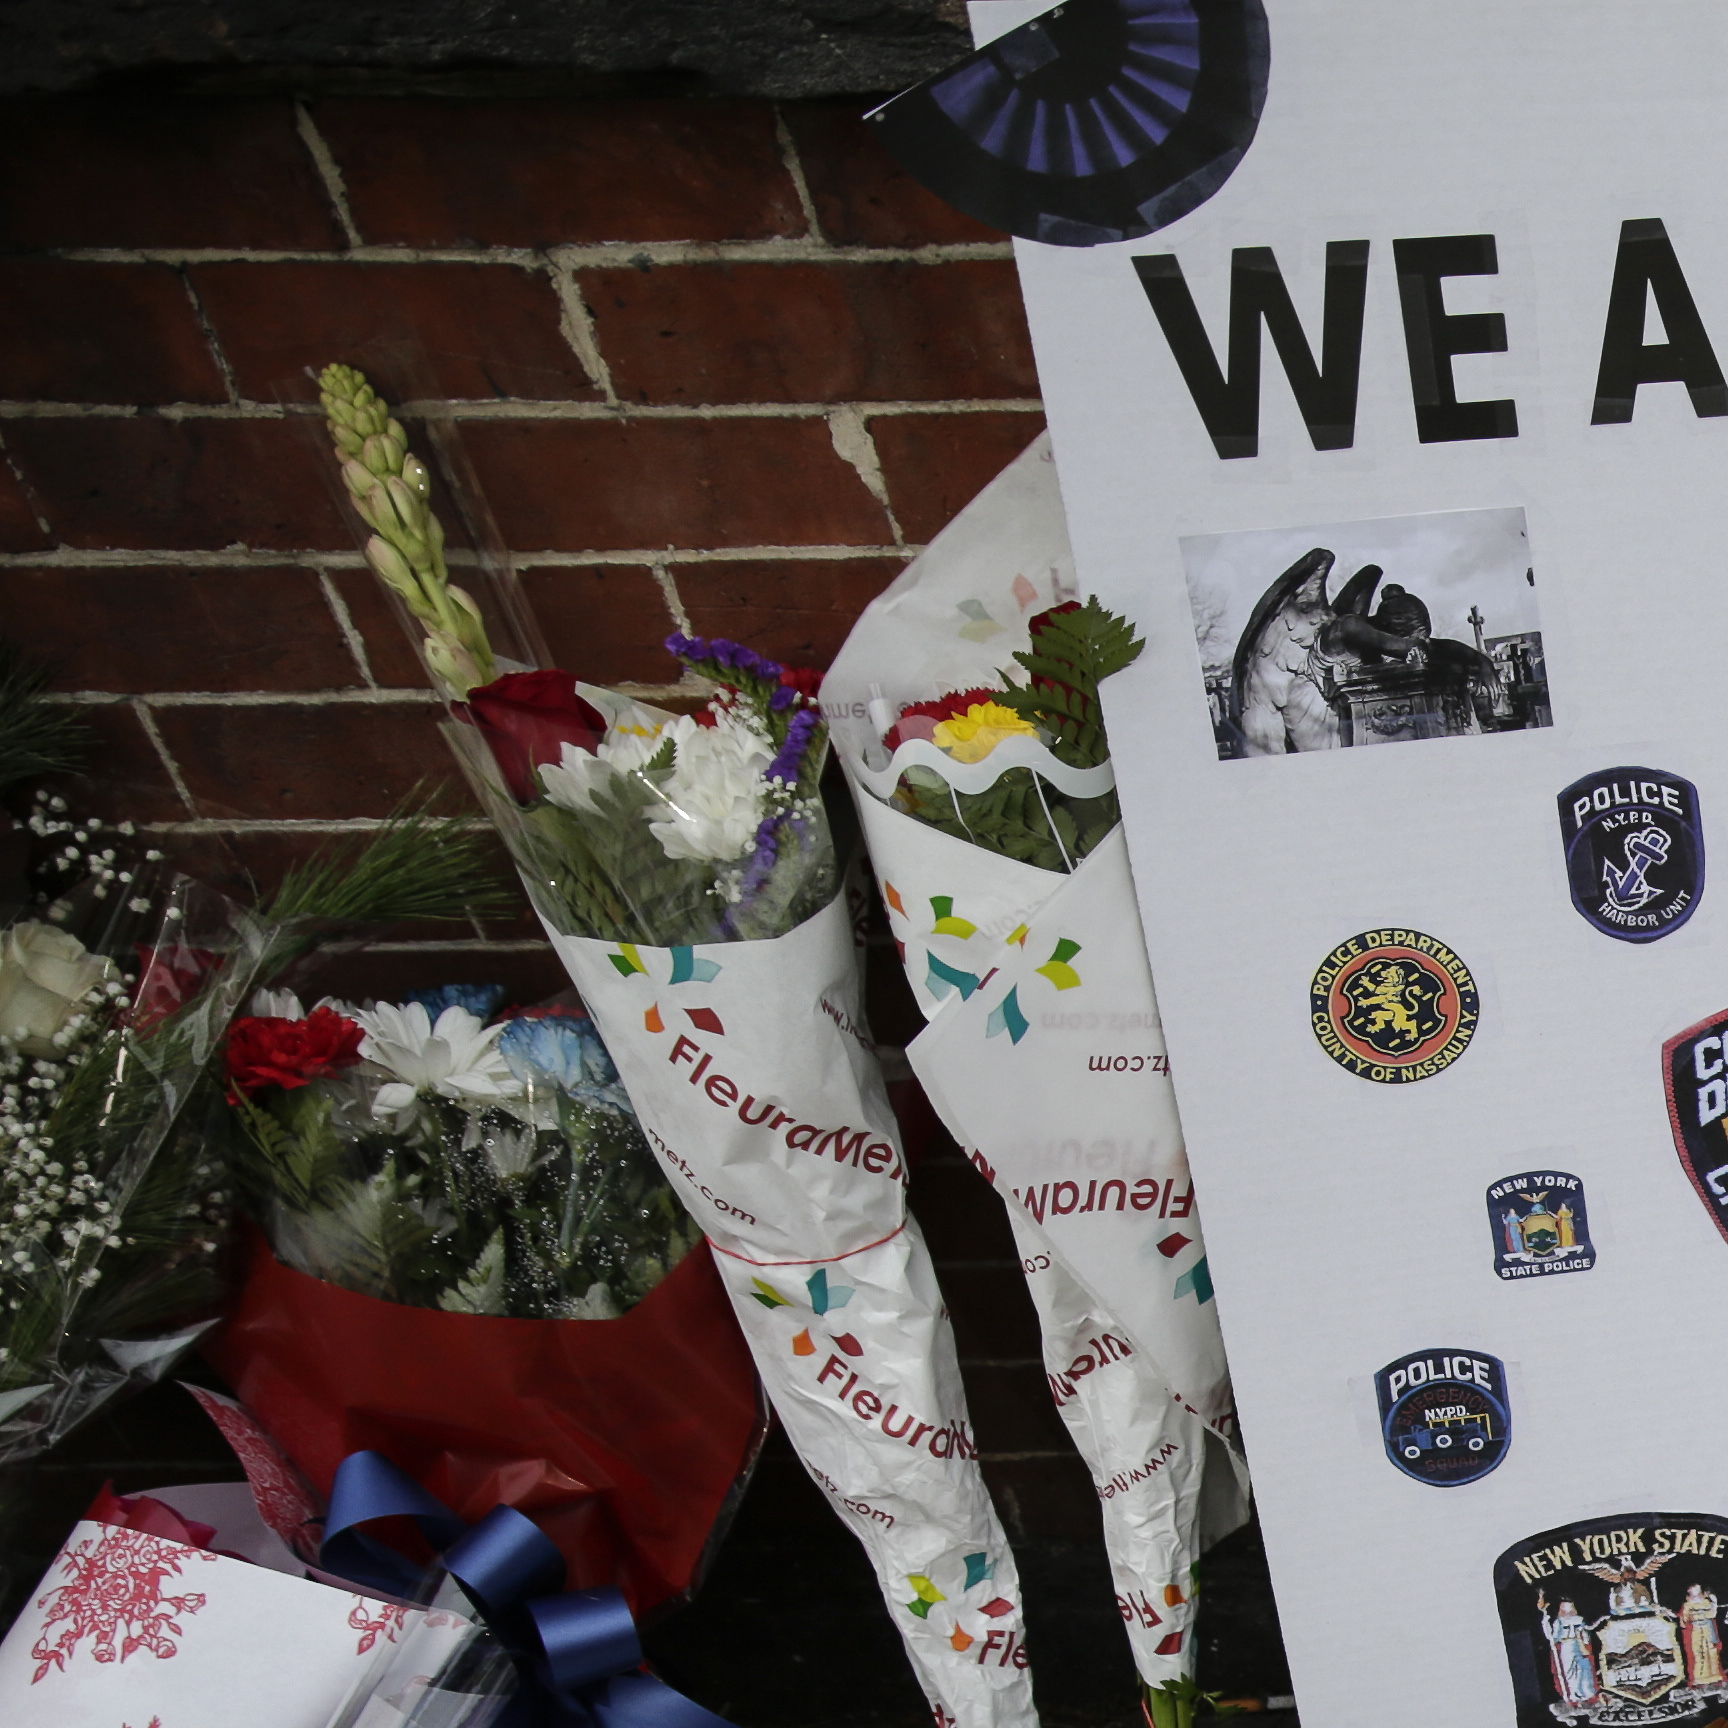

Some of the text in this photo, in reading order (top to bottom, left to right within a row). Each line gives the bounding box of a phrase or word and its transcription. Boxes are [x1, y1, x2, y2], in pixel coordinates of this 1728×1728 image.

[1131, 234, 1519, 460] WE
[1574, 781, 1683, 829] POLICE
[1599, 890, 1691, 926] HARBOR UNIT
[1313, 931, 1476, 996] POLICE DEPARTMENT
[1313, 1012, 1369, 1074] COUNTY
[1371, 1067, 1396, 1082] OF
[1491, 1176, 1578, 1199] NEW YORK
[1501, 1265, 1540, 1278] STATE
[1544, 1258, 1590, 1273] POLICE
[1389, 1356, 1492, 1402] POLICE
[1397, 1388, 1490, 1426] EMERGENCY
[1425, 1405, 1469, 1421] N.Y.P.D.
[1425, 1456, 1478, 1472] SQUAD
[1514, 1543, 1572, 1585] NEW
[1575, 1528, 1647, 1562] YORK
